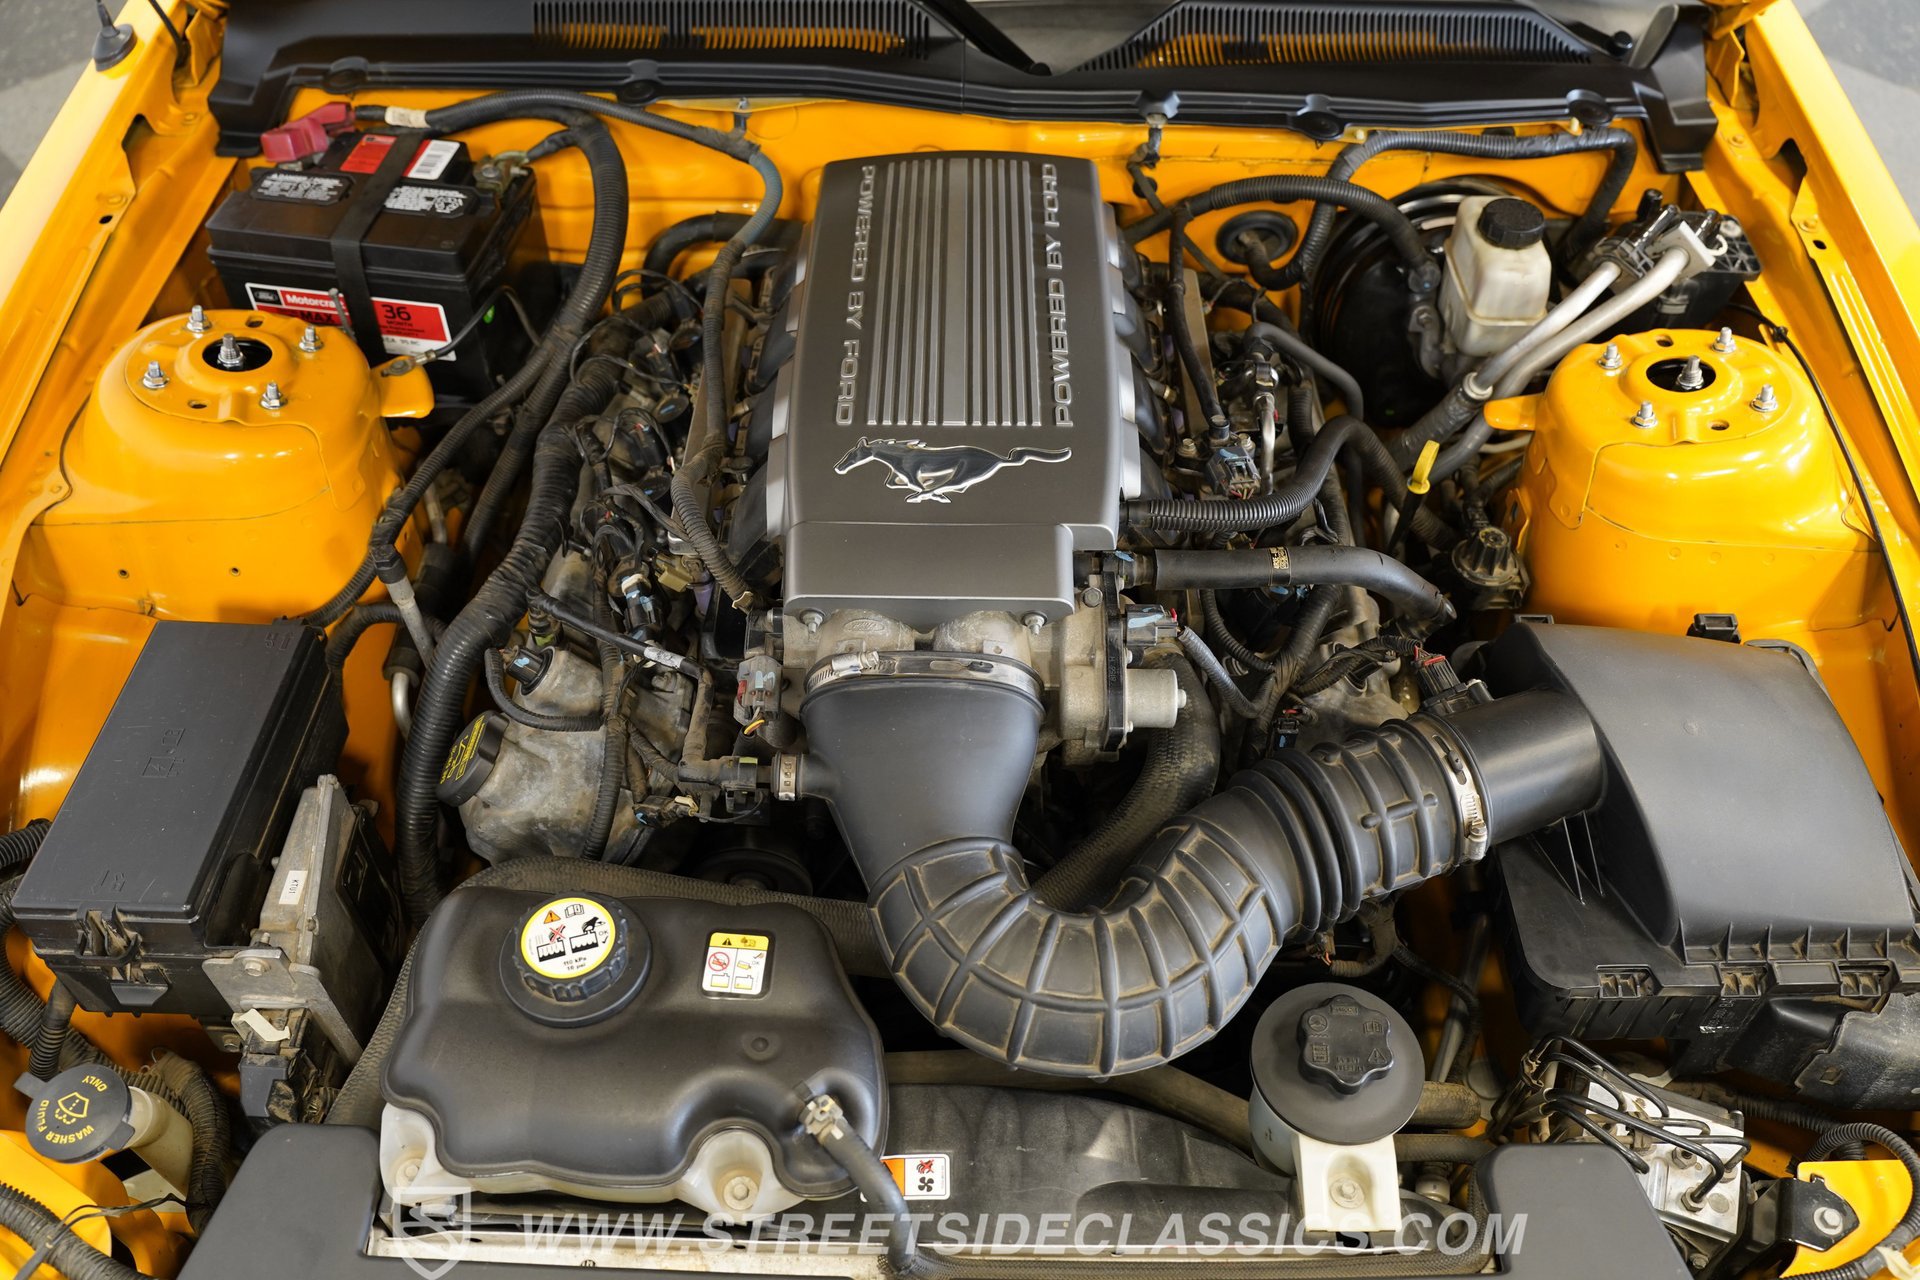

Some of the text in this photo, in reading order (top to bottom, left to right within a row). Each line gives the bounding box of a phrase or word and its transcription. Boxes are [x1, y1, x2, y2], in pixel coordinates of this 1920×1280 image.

[381, 304, 412, 321] 36
[835, 165, 876, 426] POWERED BY FORD
[1041, 163, 1074, 427] POWERED BY FORD
[37, 1075, 108, 1144] WASHER FLUID ONLY
